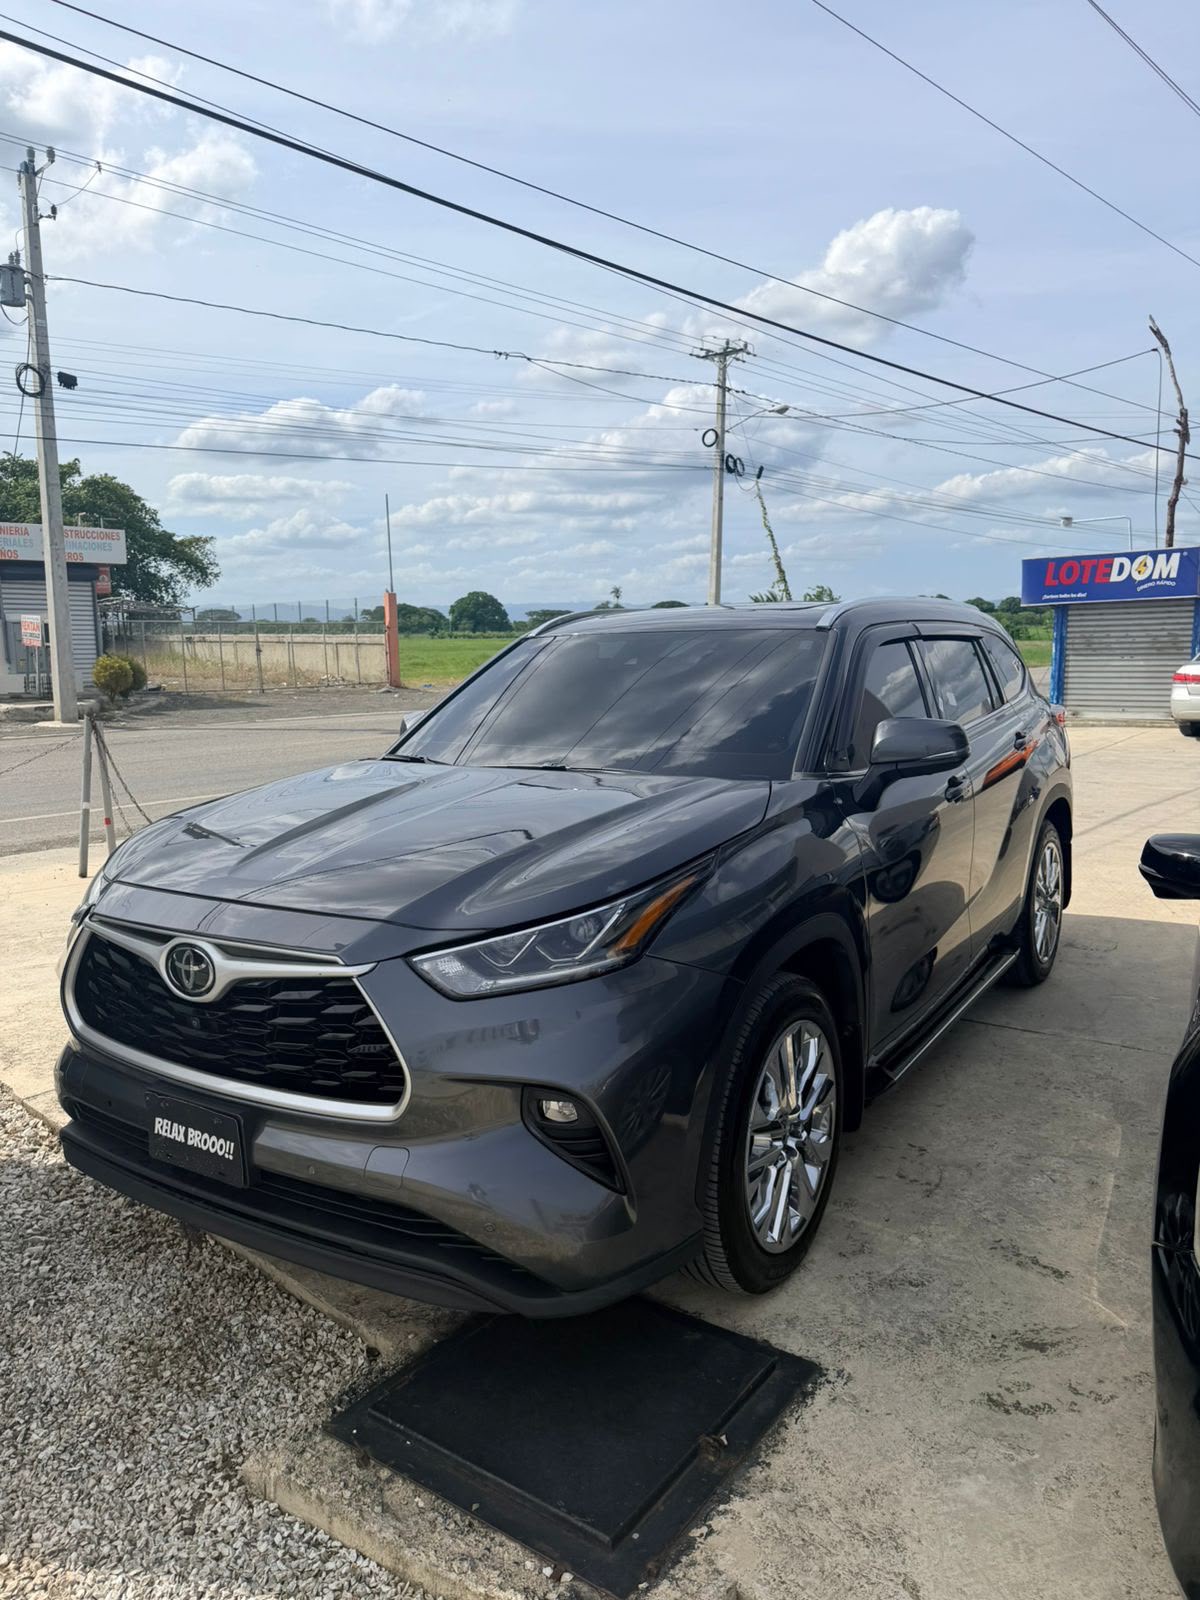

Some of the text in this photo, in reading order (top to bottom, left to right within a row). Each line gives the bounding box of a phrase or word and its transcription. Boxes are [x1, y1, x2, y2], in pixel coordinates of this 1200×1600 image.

[64, 528, 121, 541] STRUCCIONES
[1044, 552, 1181, 586] LOTEDOM
[154, 1117, 235, 1161] RELAX BROOO!!
